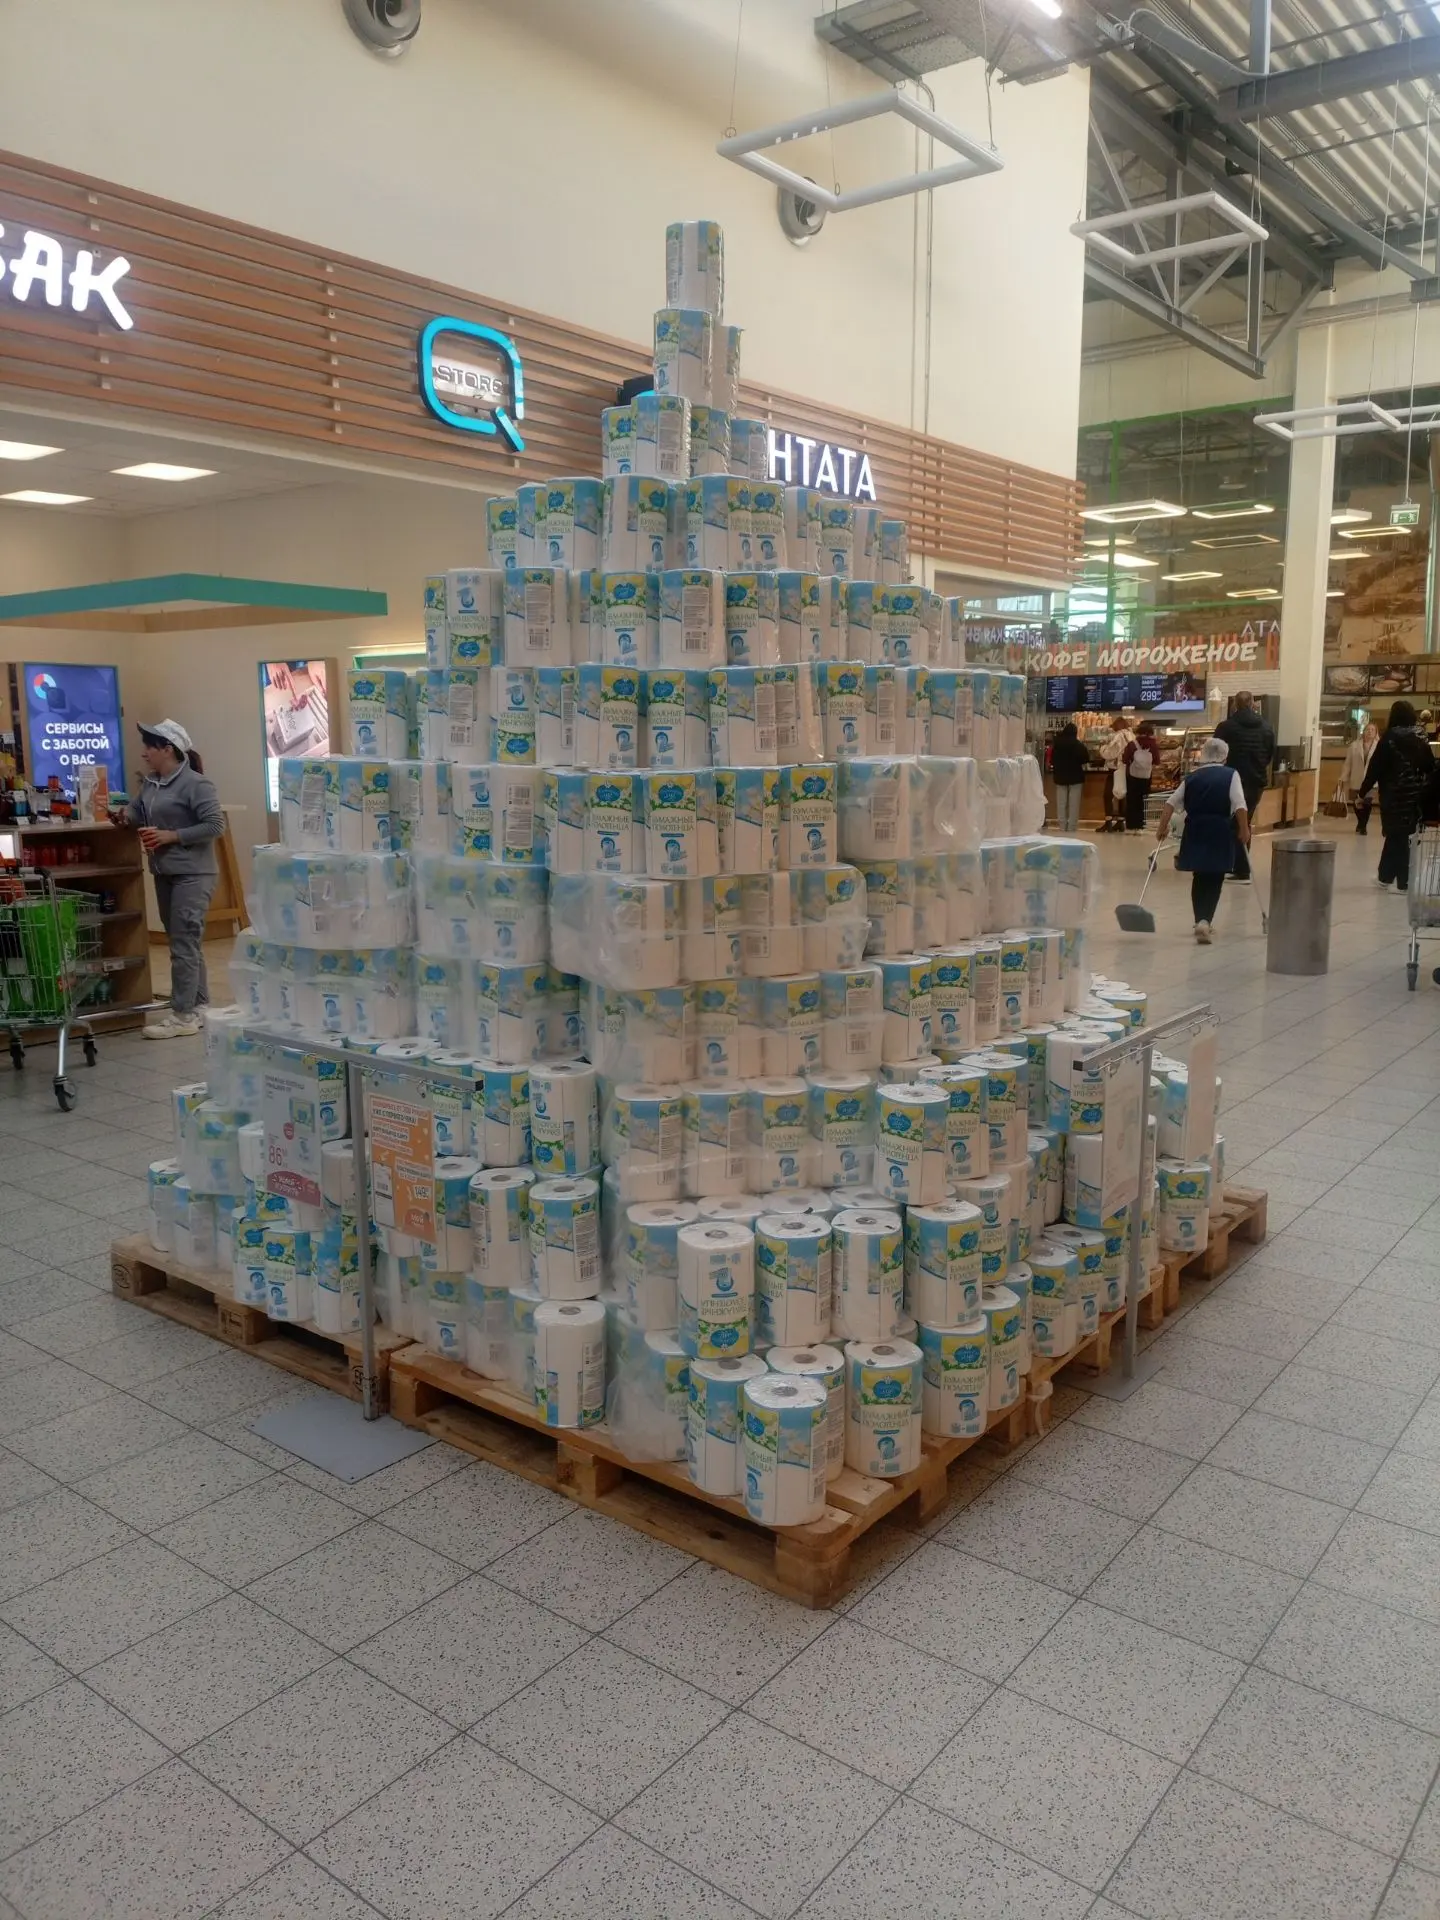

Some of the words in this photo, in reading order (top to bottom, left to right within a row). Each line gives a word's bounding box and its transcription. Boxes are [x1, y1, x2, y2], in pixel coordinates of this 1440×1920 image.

[0, 223, 134, 330] АК
[437, 364, 504, 396] STORE
[767, 428, 877, 501] НТАТА
[1027, 650, 1088, 672] КОФЕ
[1096, 641, 1259, 668] МОРОЖЕНОЕ
[1141, 690, 1157, 701] 299
[45, 722, 104, 735] СЕРВИСЫ
[41, 739, 51, 750] С
[53, 736, 109, 750] ЗАБОТОЙ
[59, 754, 70, 766] О
[72, 754, 96, 766] ВАС
[268, 1145, 282, 1166] 86
